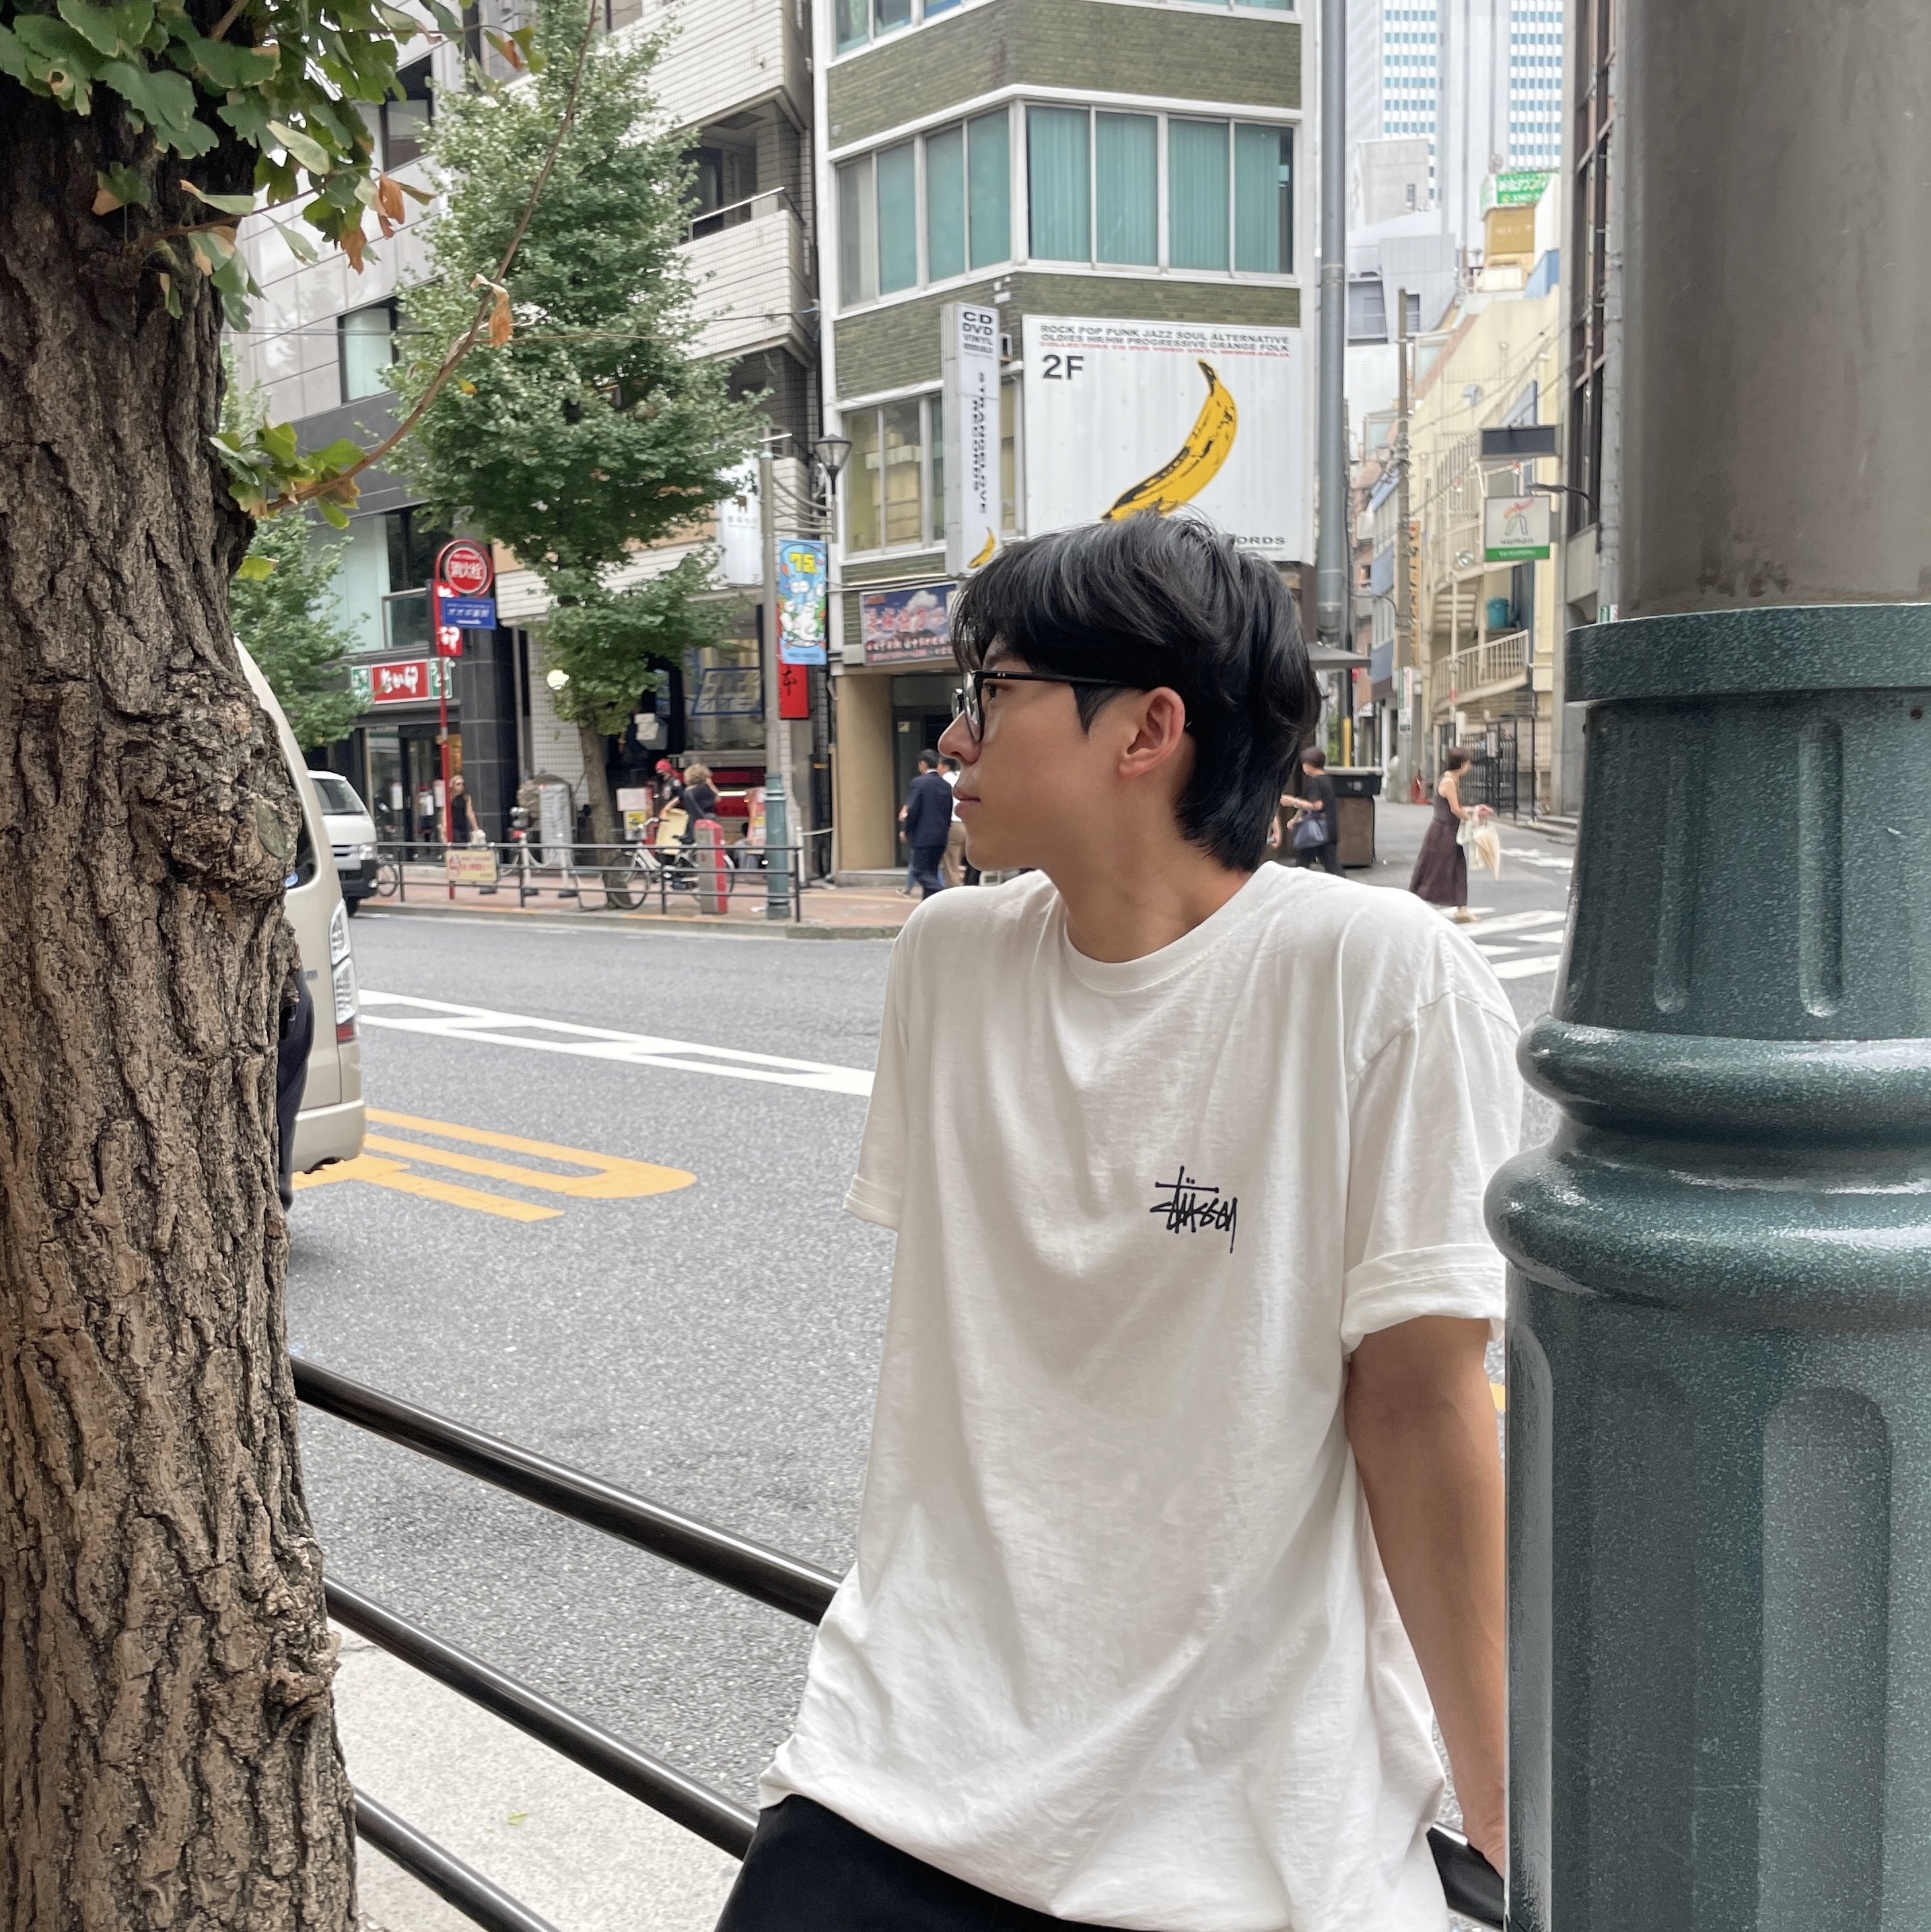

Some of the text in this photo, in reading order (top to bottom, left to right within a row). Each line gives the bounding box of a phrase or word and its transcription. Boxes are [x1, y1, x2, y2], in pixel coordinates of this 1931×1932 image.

[963, 312, 993, 324] CD
[963, 323, 993, 335] DVD
[1041, 325, 1290, 344] ROCK POP PUNK JAZZ SOUL ALTERNATIVE
[1041, 334, 1084, 342] OLDIES
[1127, 337, 1208, 348] PROGRESSIVE
[1260, 343, 1289, 351] FOLK
[1041, 354, 1084, 380] 2F
[450, 561, 483, 580] 消火栓
